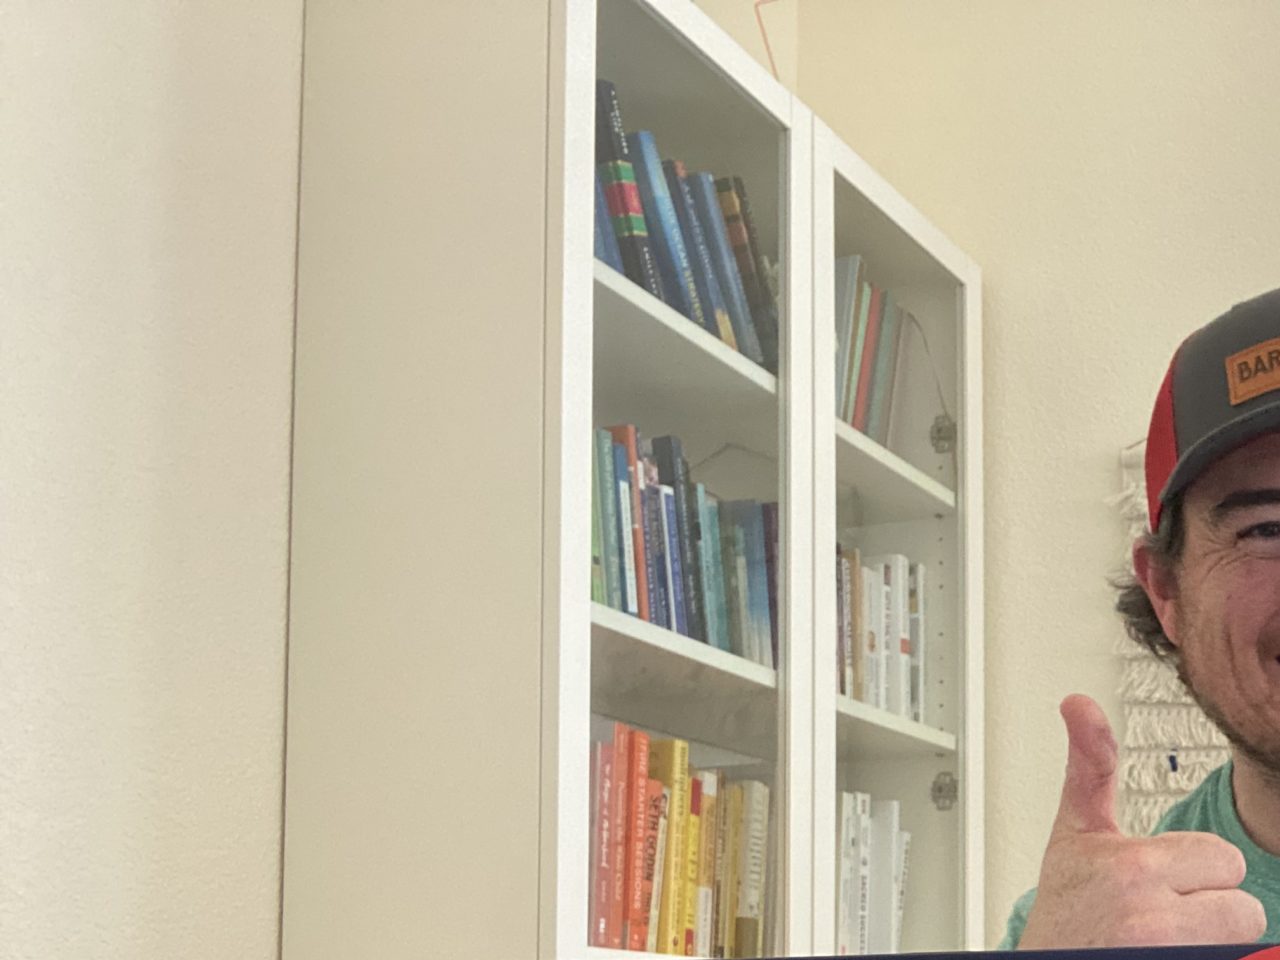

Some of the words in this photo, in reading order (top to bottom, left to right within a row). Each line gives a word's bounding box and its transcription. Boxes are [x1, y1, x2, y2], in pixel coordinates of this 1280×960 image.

[672, 227, 688, 268] OCEAN
[684, 269, 706, 324] STRATEGY
[635, 777, 646, 839] STARTER
[647, 795, 660, 831] SETH
[633, 840, 644, 910] SESSIONS
[643, 835, 658, 882] GODIN
